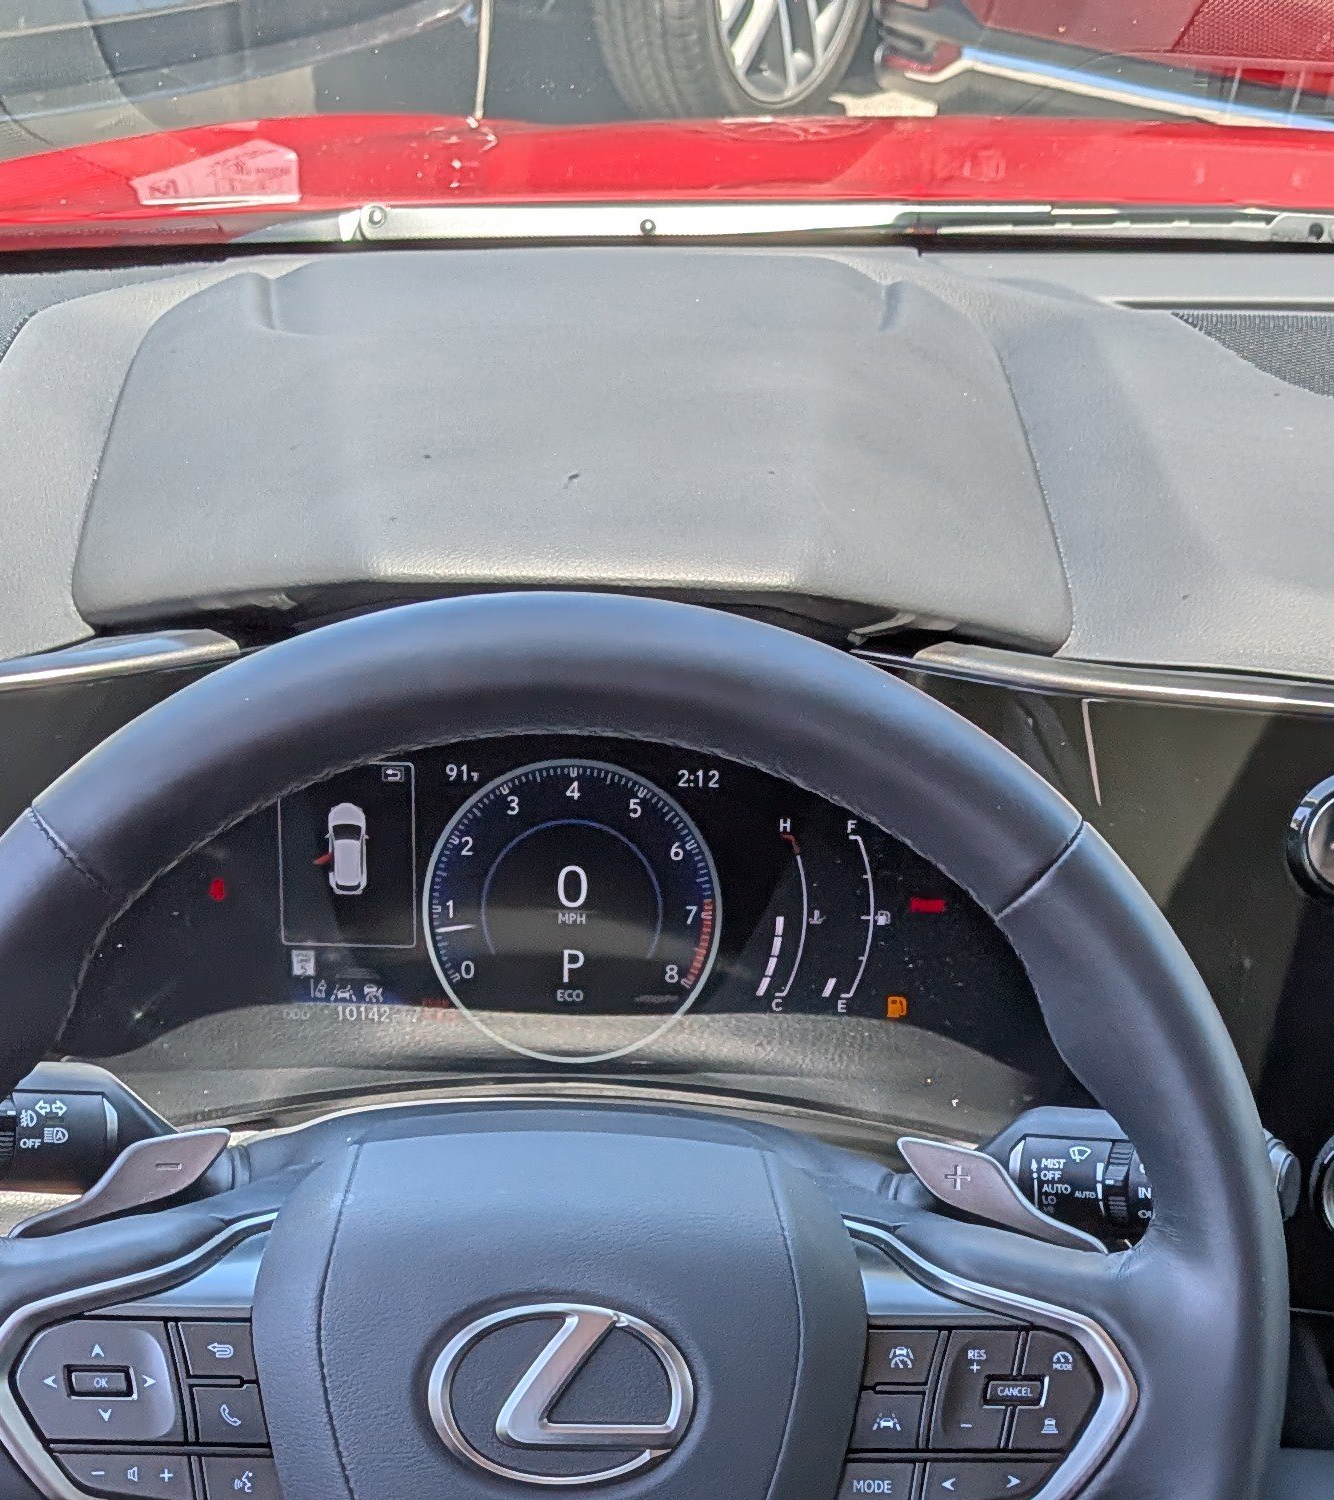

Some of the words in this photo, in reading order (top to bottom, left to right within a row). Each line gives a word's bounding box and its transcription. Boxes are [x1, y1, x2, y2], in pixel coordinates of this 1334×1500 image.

[677, 769, 720, 789] 2:12
[565, 781, 581, 801] 4
[506, 796, 519, 815] 3
[628, 798, 642, 818] 5
[779, 818, 791, 833] H
[846, 819, 858, 834] F
[460, 836, 474, 856] 2
[670, 842, 684, 861] 6
[556, 865, 588, 908] 0
[446, 900, 455, 919] 1
[685, 905, 699, 925] 7
[557, 911, 587, 926] MPH
[460, 960, 475, 979] 0
[562, 949, 585, 983] P
[664, 964, 679, 983] 8
[556, 989, 584, 1002] ECO
[771, 998, 783, 1012] C
[837, 1000, 847, 1013] E
[19, 1138, 41, 1149] OFF
[1040, 1158, 1066, 1169] MIST
[1040, 1170, 1062, 1181] OFF
[1041, 1183, 1072, 1195] AUTO
[1074, 1190, 1097, 1199] AUTO
[967, 1349, 987, 1361] RES
[1052, 1362, 1073, 1372] MODE
[93, 1377, 108, 1389] OK
[997, 1386, 1034, 1398] CANCEL
[852, 1479, 893, 1494] MODE
